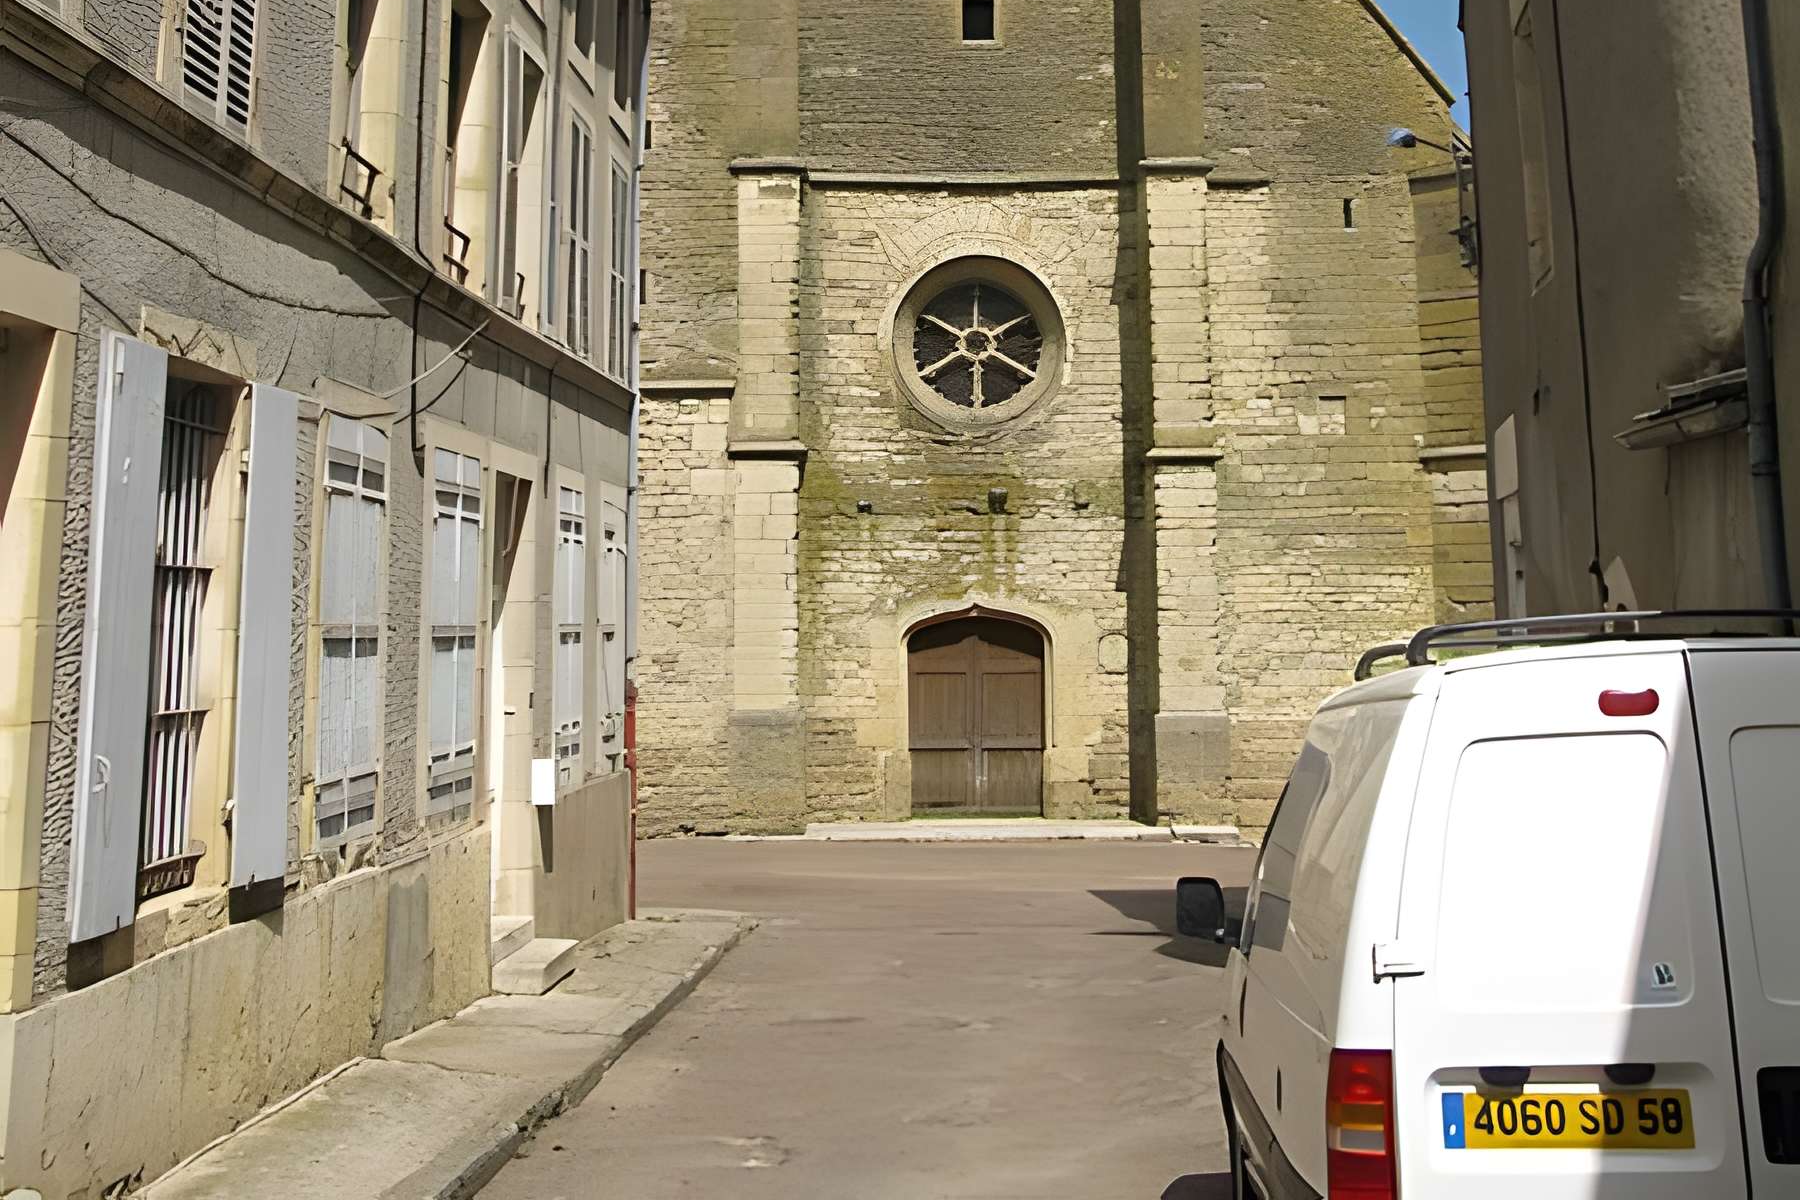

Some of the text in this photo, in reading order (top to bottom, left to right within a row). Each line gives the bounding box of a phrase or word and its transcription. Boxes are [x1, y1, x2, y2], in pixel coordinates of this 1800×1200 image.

[1474, 1097, 1683, 1136] 4060 SD 58
